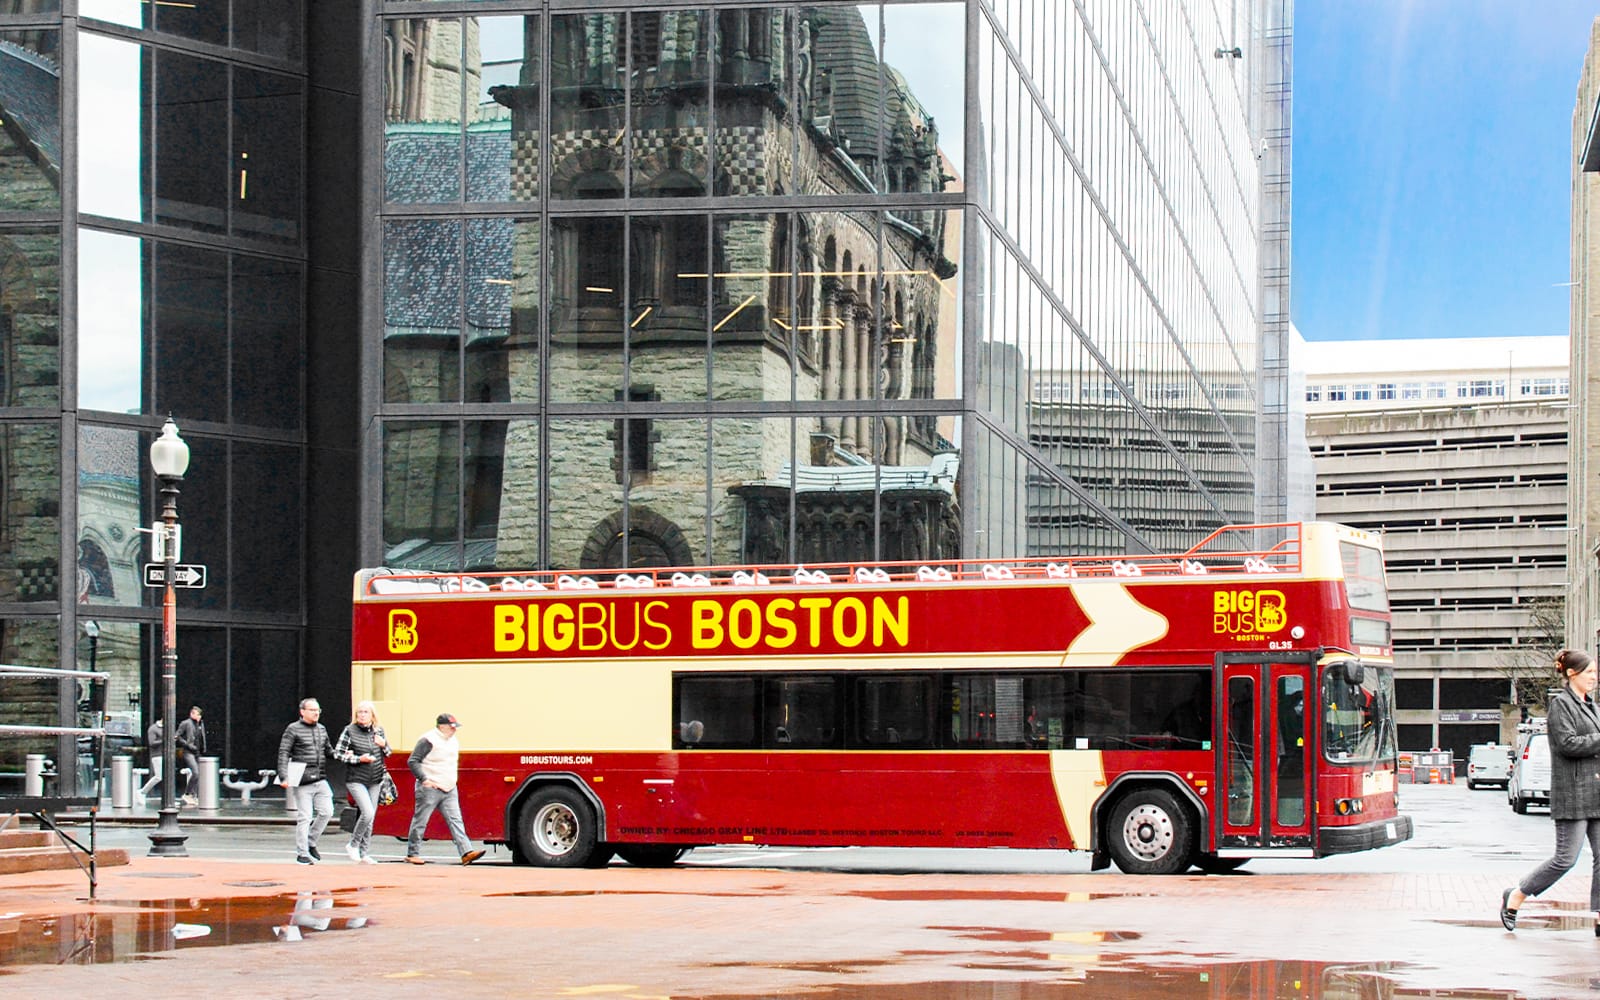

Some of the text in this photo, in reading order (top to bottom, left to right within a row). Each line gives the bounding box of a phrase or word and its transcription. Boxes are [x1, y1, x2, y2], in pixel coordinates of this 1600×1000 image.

[1214, 590, 1254, 613] BIG
[691, 596, 909, 649] BOSTON
[1214, 613, 1254, 633] BUS
[1269, 641, 1293, 649] GL35
[520, 756, 593, 765] BIGBUSTOURS.COM
[673, 827, 715, 835] CHICAGO
[718, 827, 743, 835] GRAY
[746, 827, 767, 835] LINE
